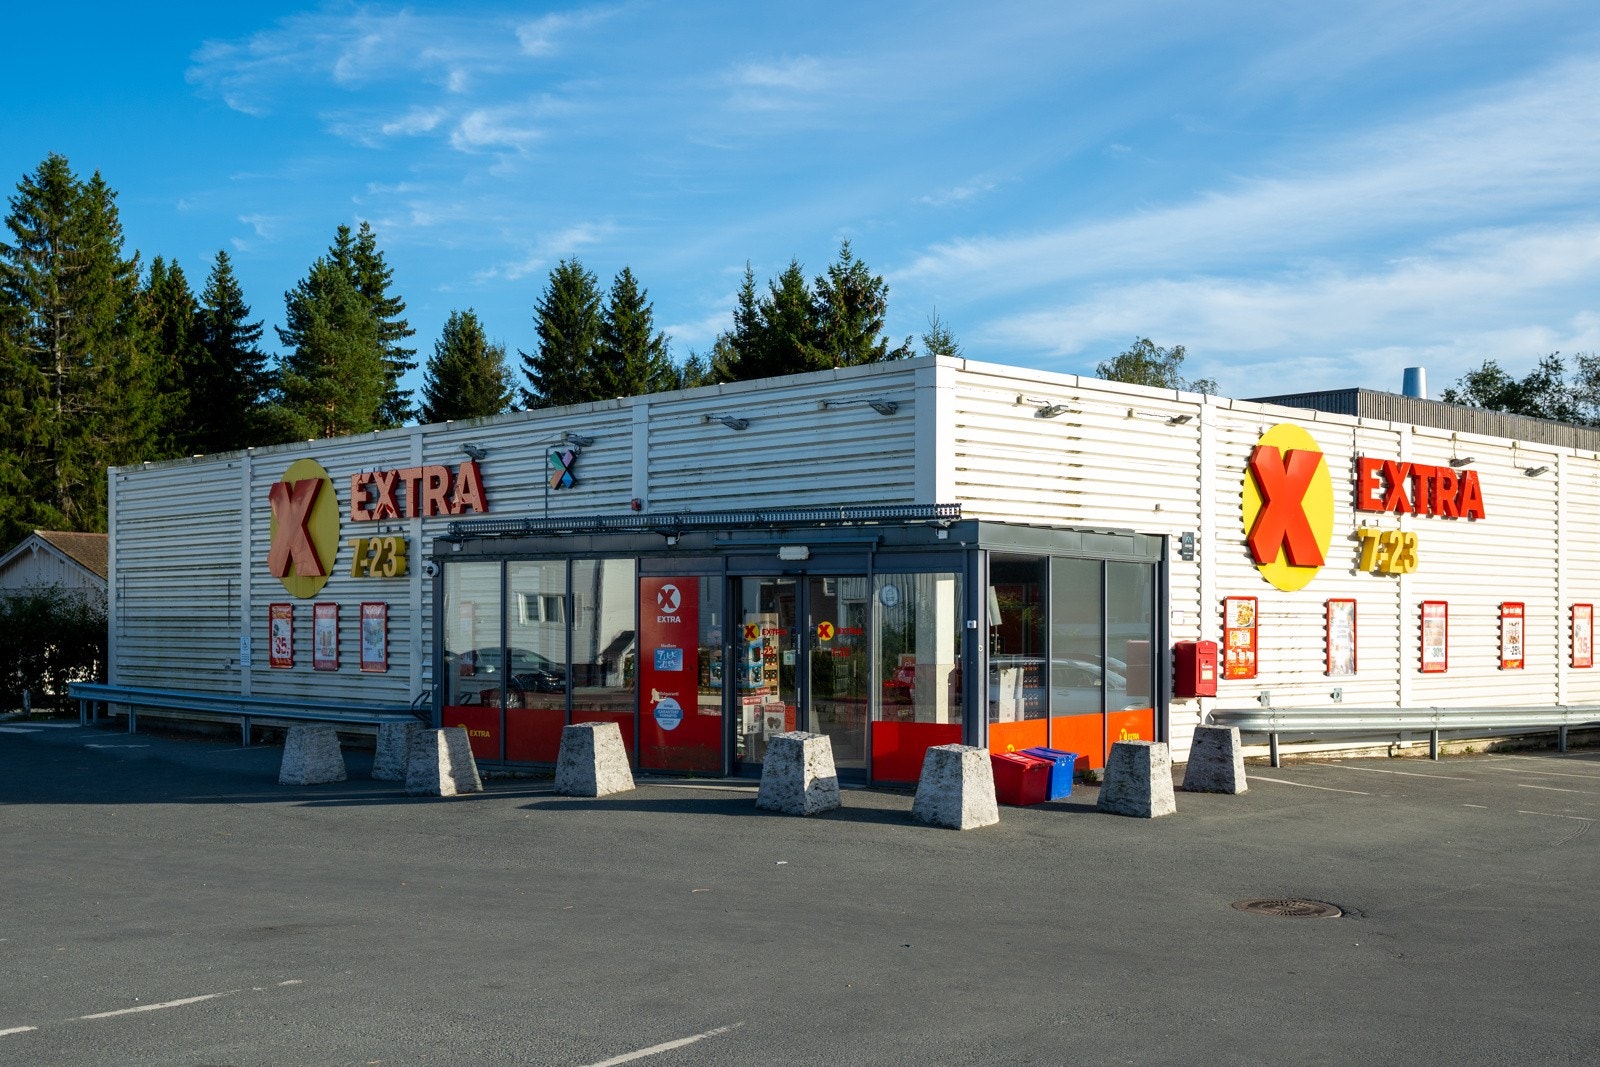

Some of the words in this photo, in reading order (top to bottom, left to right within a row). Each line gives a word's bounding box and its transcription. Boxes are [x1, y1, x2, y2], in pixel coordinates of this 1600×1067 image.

[351, 461, 488, 521] EXTRA
[1357, 456, 1485, 519] EXTRA
[348, 537, 404, 578] 7-23
[1358, 528, 1418, 574] 7-23
[656, 615, 681, 623] EXTRA
[762, 628, 787, 636] EXTRA
[470, 730, 490, 738] EXTRA
